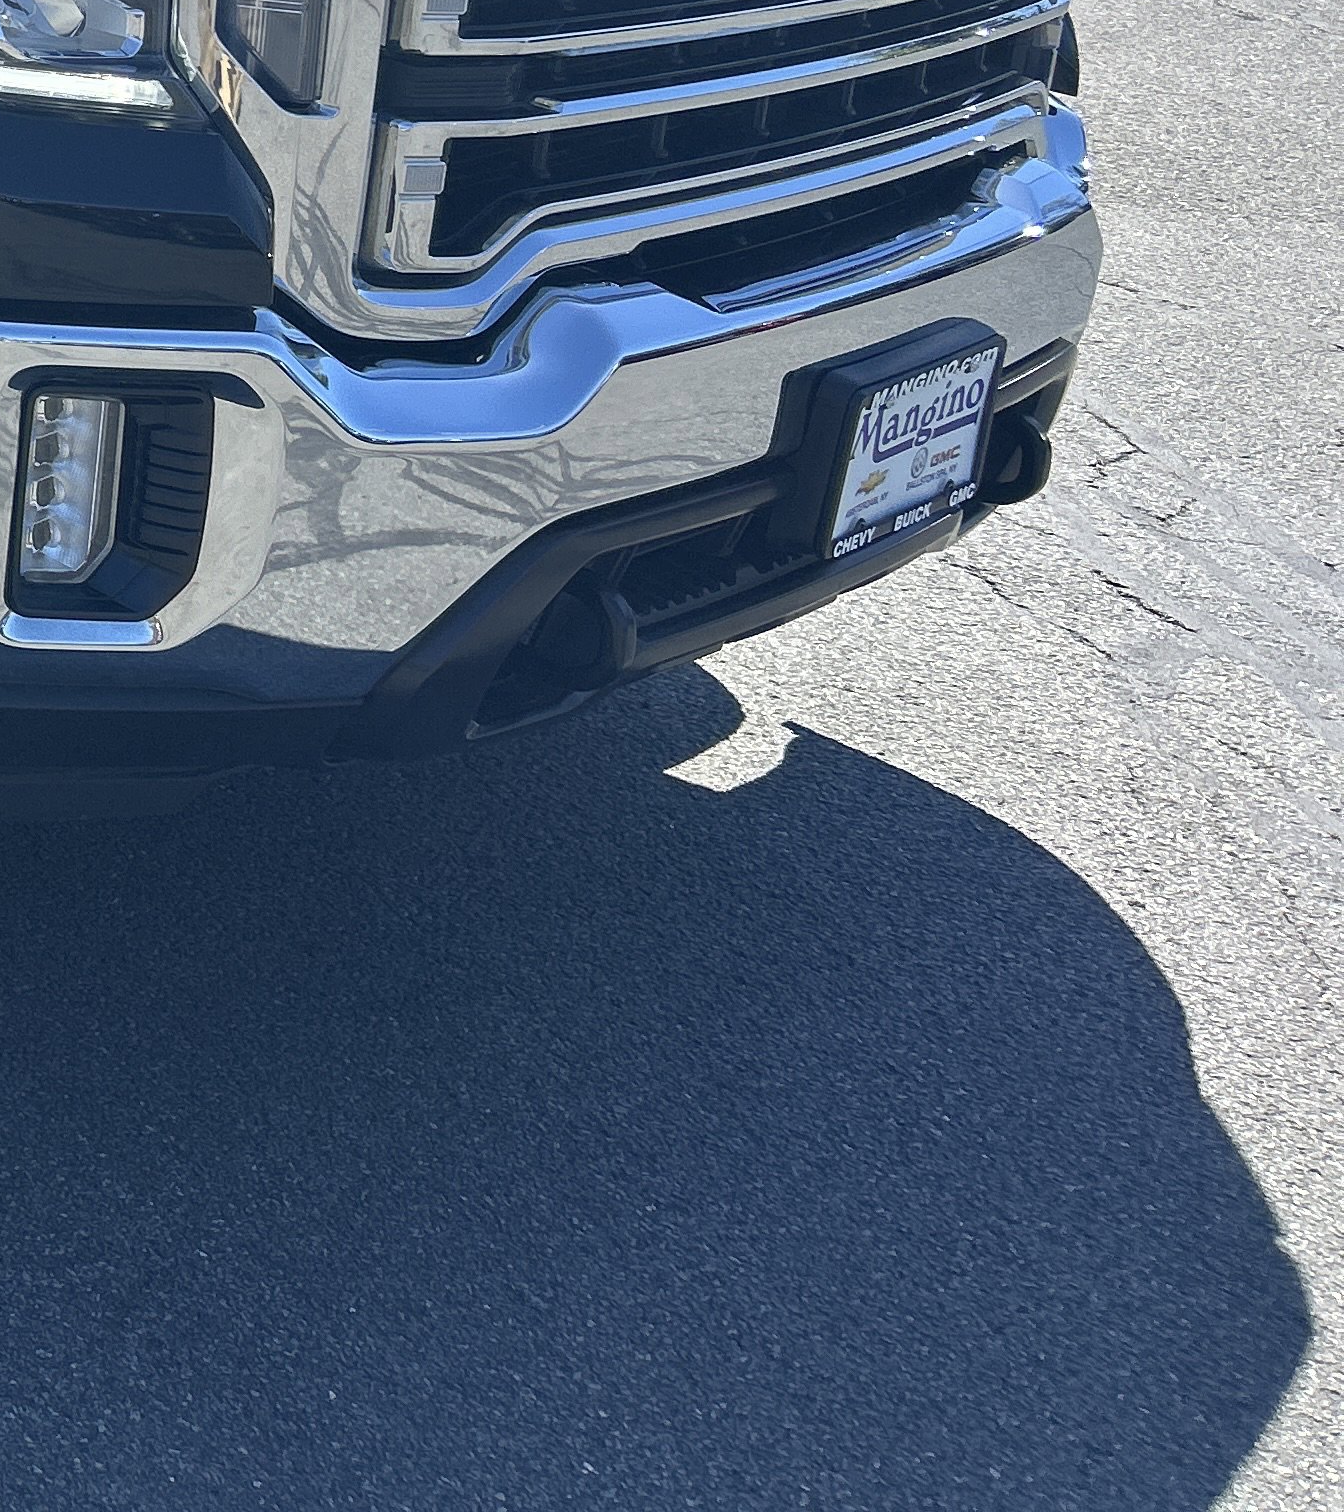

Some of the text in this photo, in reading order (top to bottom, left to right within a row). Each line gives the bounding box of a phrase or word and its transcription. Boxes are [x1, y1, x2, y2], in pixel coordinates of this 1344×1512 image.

[850, 378, 985, 464] Mangino
[930, 445, 961, 468] GMC
[833, 526, 877, 558] CHEVY
[893, 501, 932, 532] BUICK
[948, 482, 977, 507] GMC
